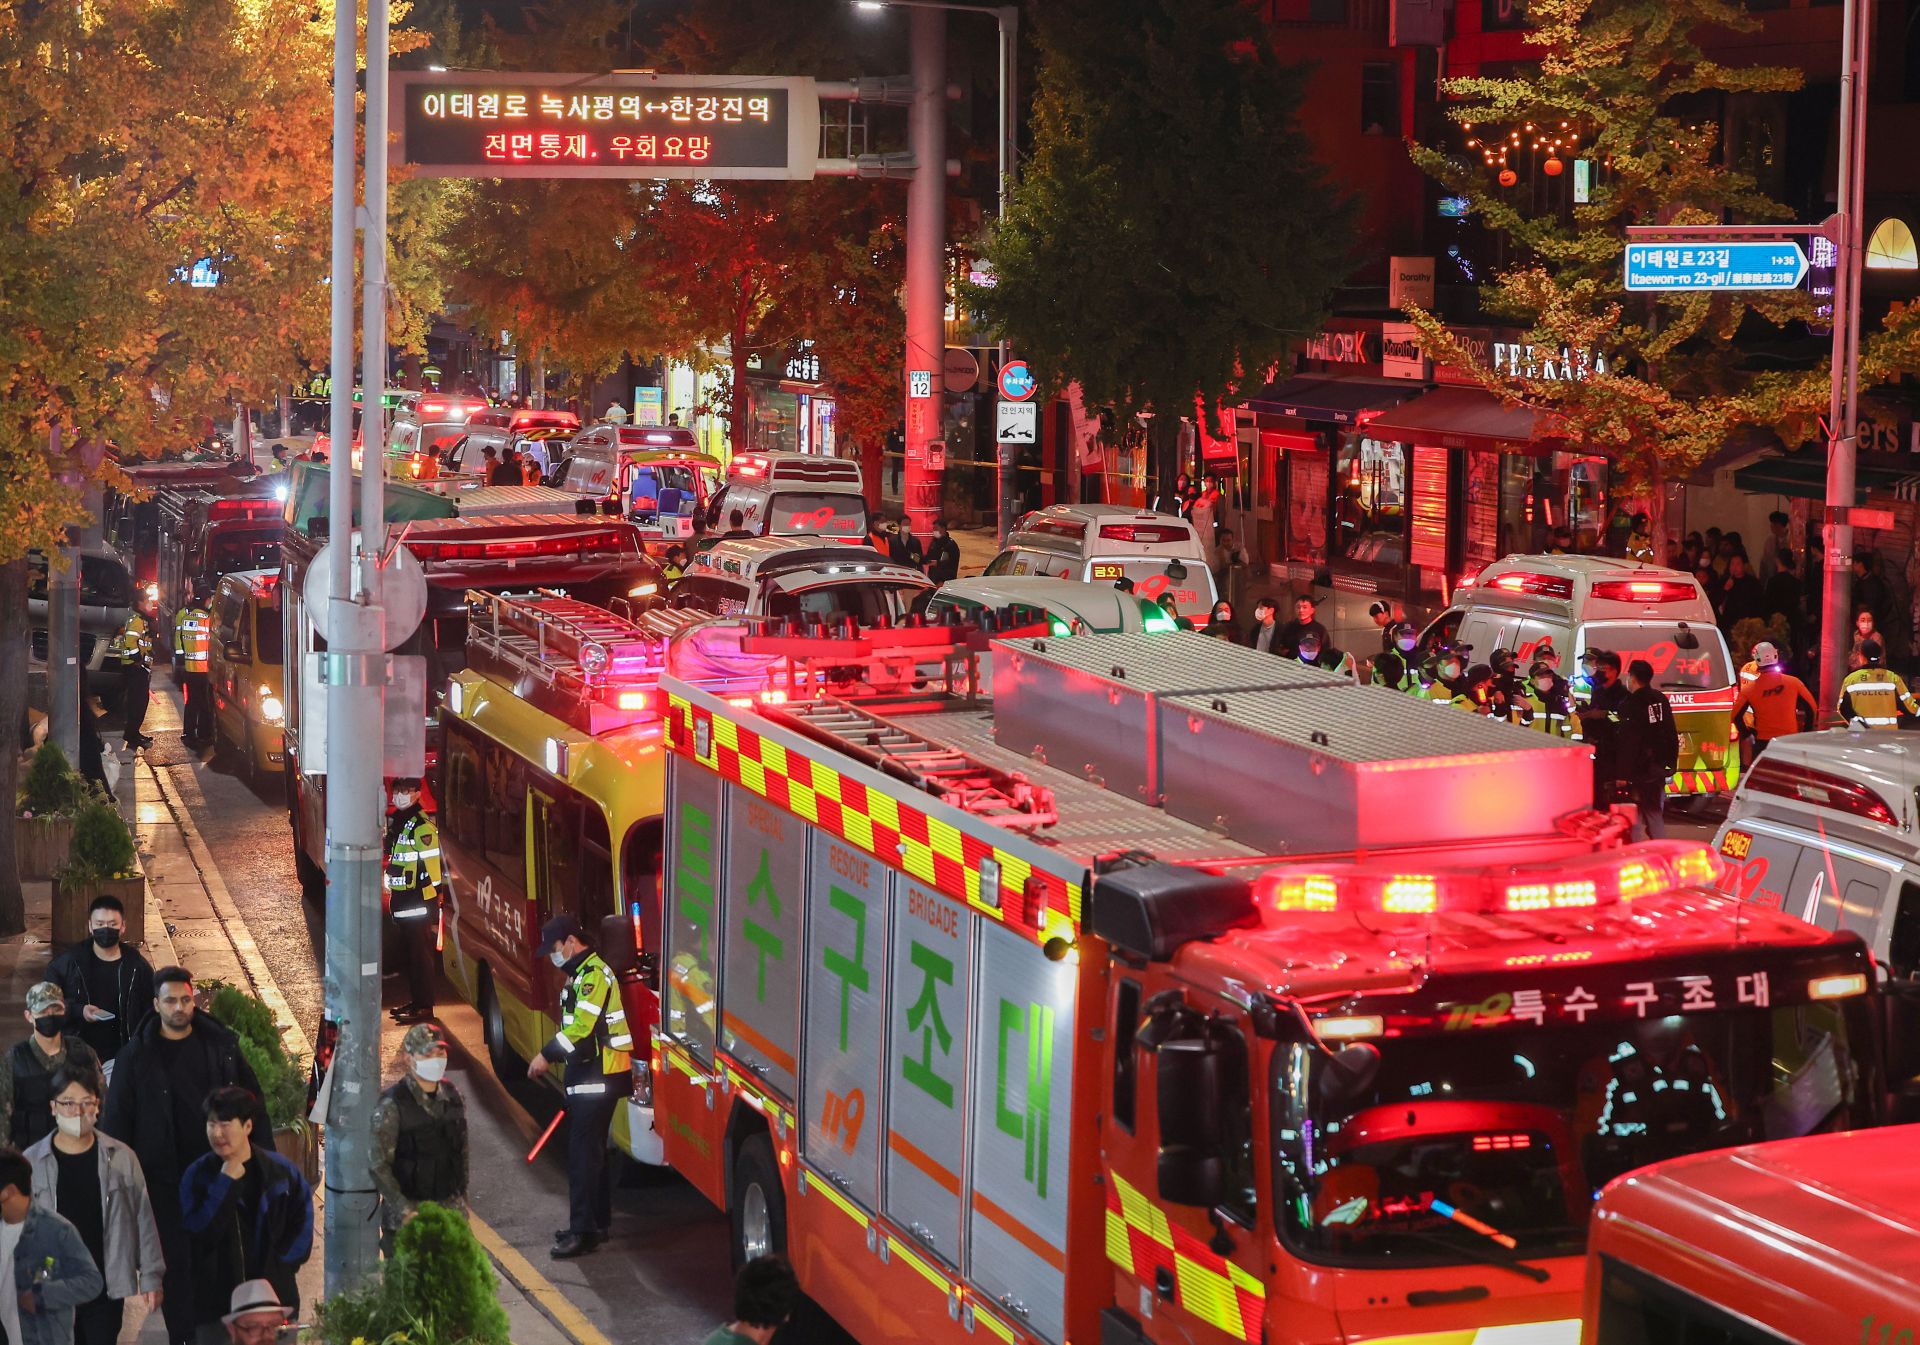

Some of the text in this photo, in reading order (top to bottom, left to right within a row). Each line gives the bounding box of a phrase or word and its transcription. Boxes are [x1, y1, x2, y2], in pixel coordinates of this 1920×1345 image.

[423, 93, 770, 122] 이태원로 녹사평역 한강진역
[484, 133, 712, 160] 전면통제. 우회요망
[1400, 272, 1431, 282] Dorothy
[1631, 272, 1692, 285] Itaewon-ro
[1693, 271, 1725, 286] 23-gil
[1383, 338, 1420, 360] Dorothy
[913, 382, 928, 396] 12
[1000, 406, 1034, 416] 견인지역
[1840, 418, 1899, 453] ers
[787, 506, 836, 529] 119
[1094, 565, 1124, 579] 금오1
[1668, 693, 1695, 705] ANCE
[747, 802, 786, 843] SPECIAL
[828, 845, 870, 889] RESCUE
[907, 887, 960, 939] BRIGADE
[1443, 992, 1513, 1032] 119
[820, 1087, 866, 1158] 119
